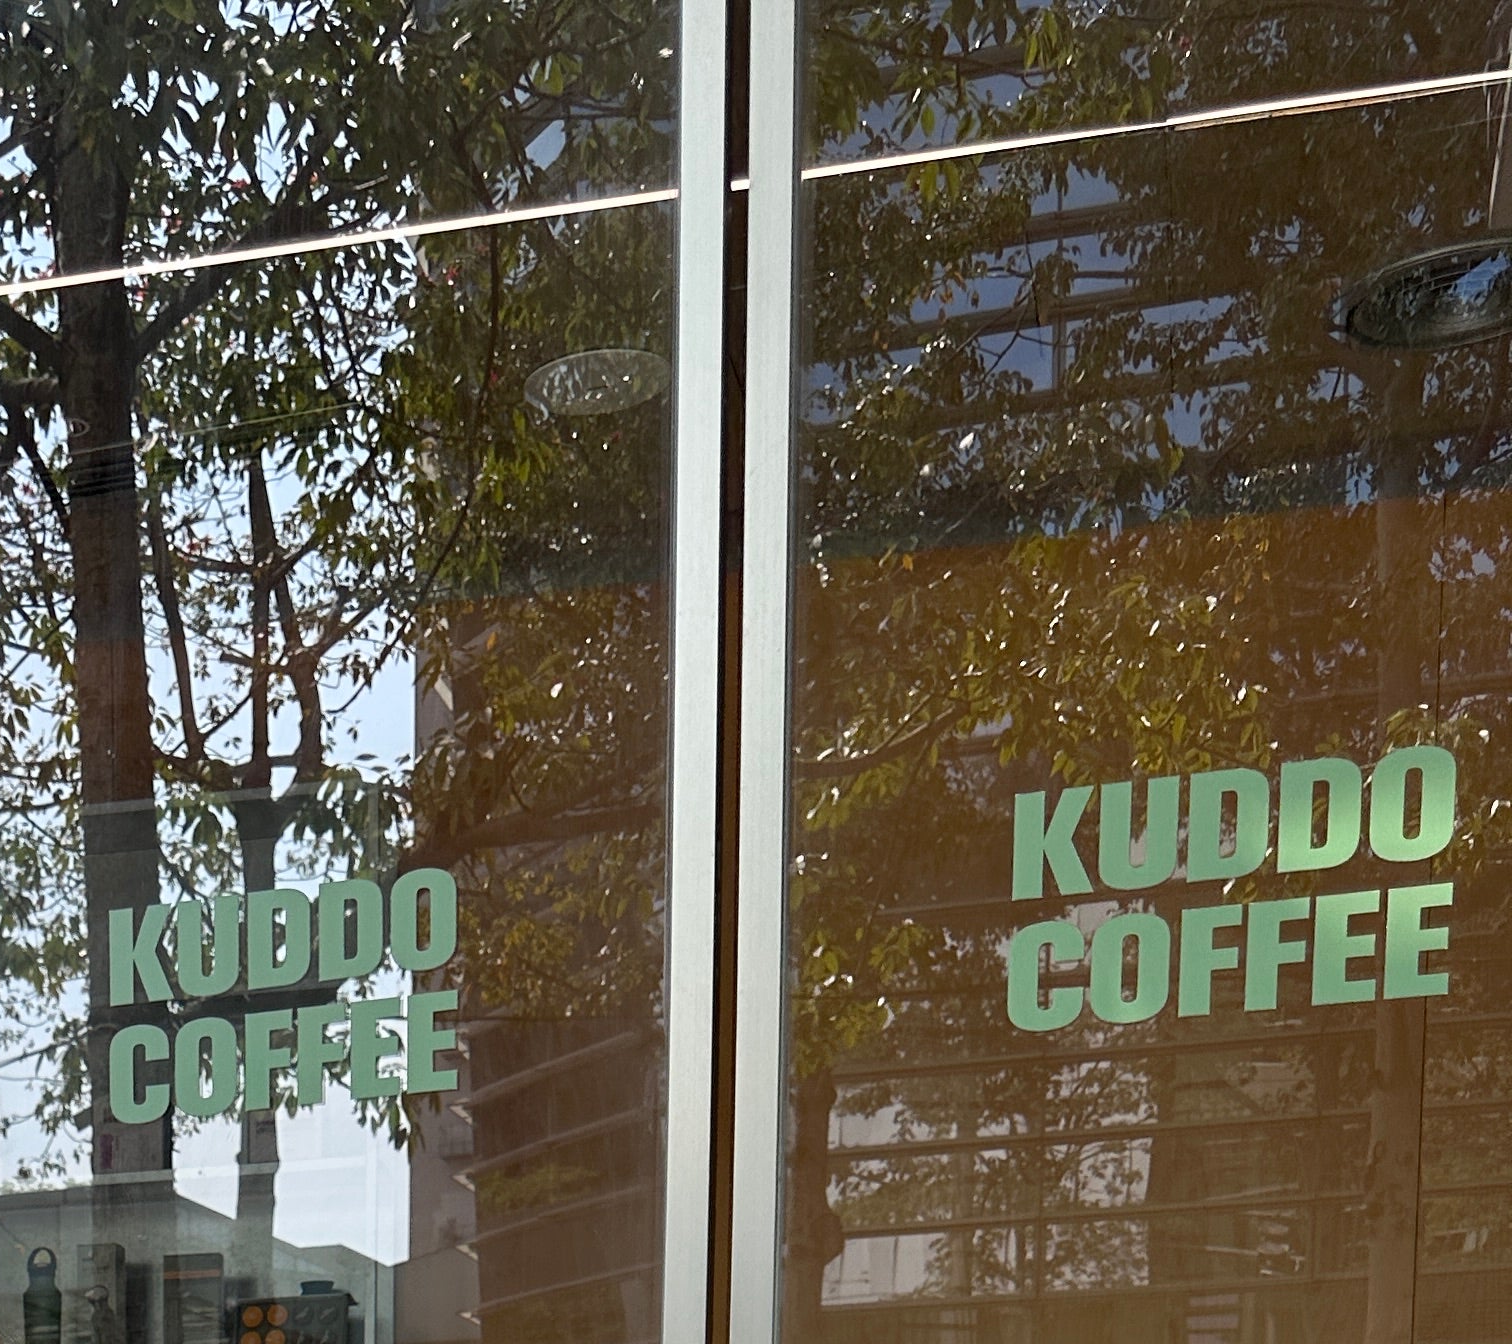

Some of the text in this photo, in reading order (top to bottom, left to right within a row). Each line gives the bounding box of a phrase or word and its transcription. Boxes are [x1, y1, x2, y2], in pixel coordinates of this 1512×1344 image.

[1012, 745, 1457, 900] KUDDO
[109, 868, 458, 1007] KUDDO
[1007, 882, 1454, 1032] COFFEE
[109, 990, 458, 1124] COFFEE
